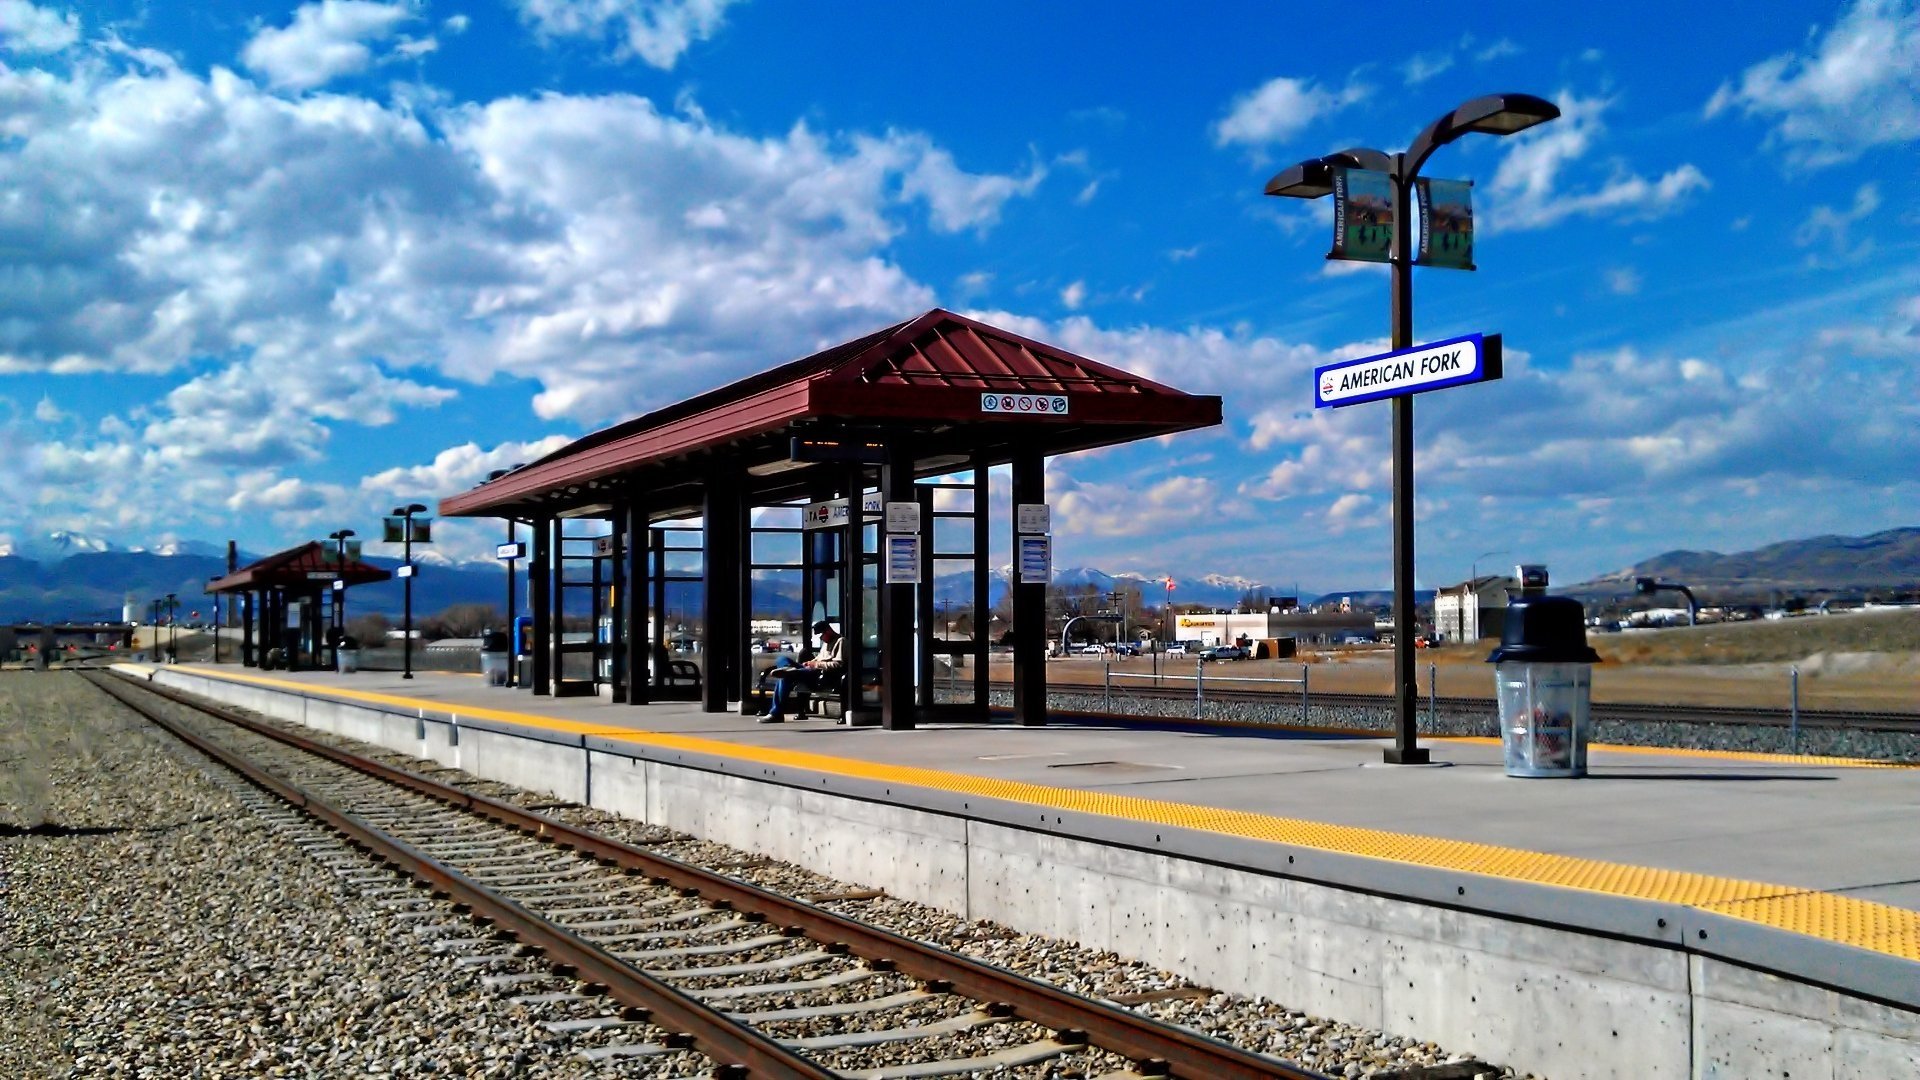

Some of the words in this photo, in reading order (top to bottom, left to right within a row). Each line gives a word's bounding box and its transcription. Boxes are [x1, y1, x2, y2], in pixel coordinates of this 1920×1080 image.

[1335, 175, 1344, 198] FORK
[1336, 199, 1345, 246] AMERICAN
[1339, 360, 1415, 391] AMERICAN
[1420, 350, 1461, 376] FORK
